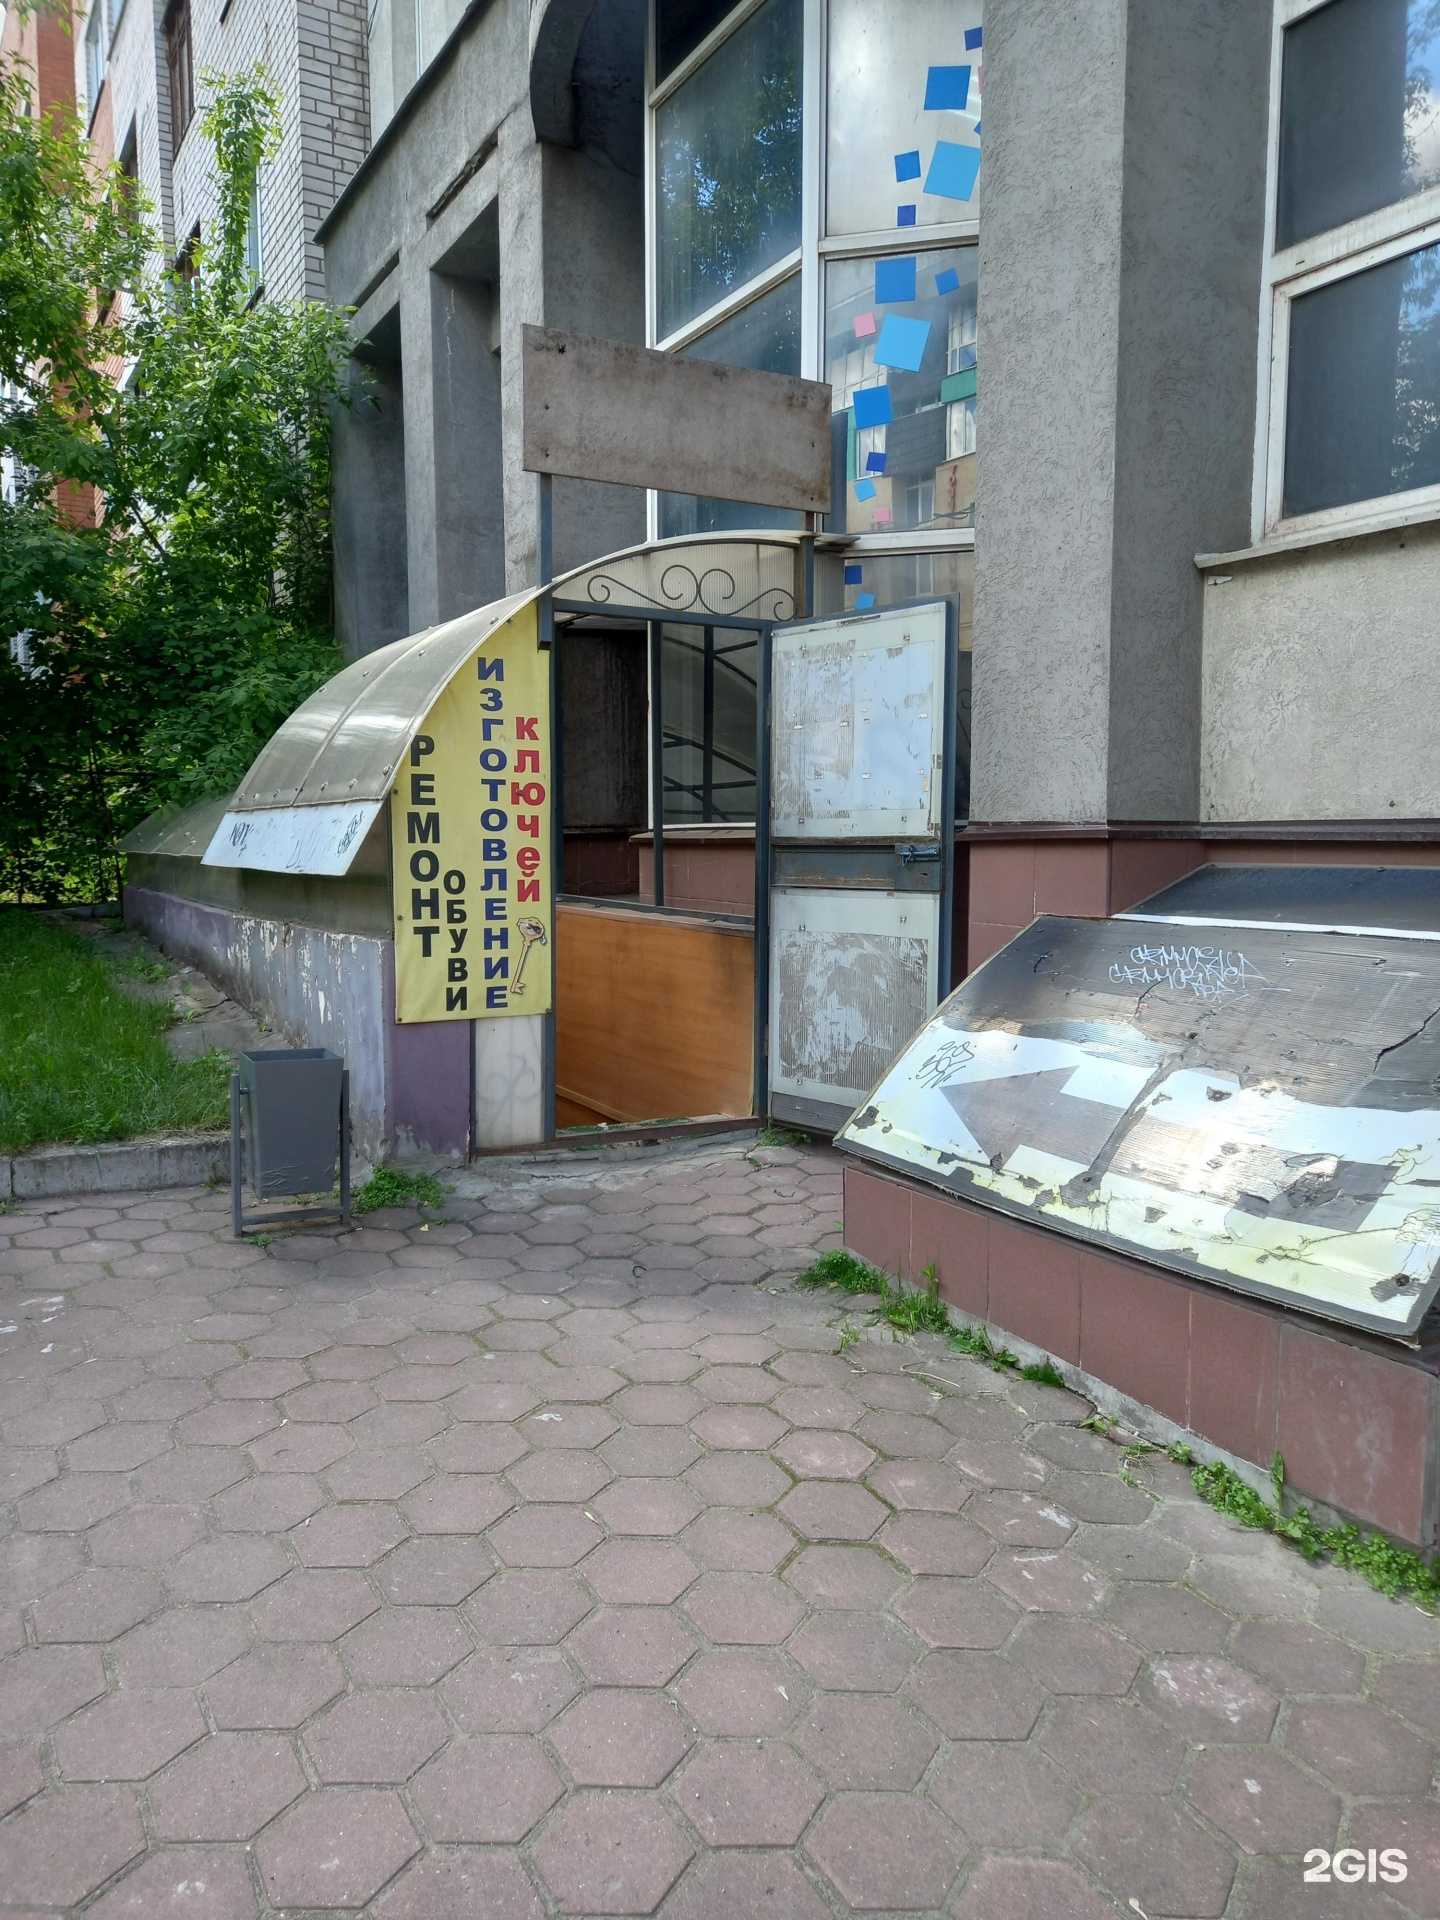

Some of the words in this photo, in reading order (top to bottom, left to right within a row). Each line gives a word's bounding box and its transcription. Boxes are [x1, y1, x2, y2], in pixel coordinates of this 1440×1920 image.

[406, 735, 441, 958] РЕМОНТ
[442, 869, 469, 1012] ОБУВИ
[476, 656, 509, 1010] ИЗГОТОВЛЕНИЕ
